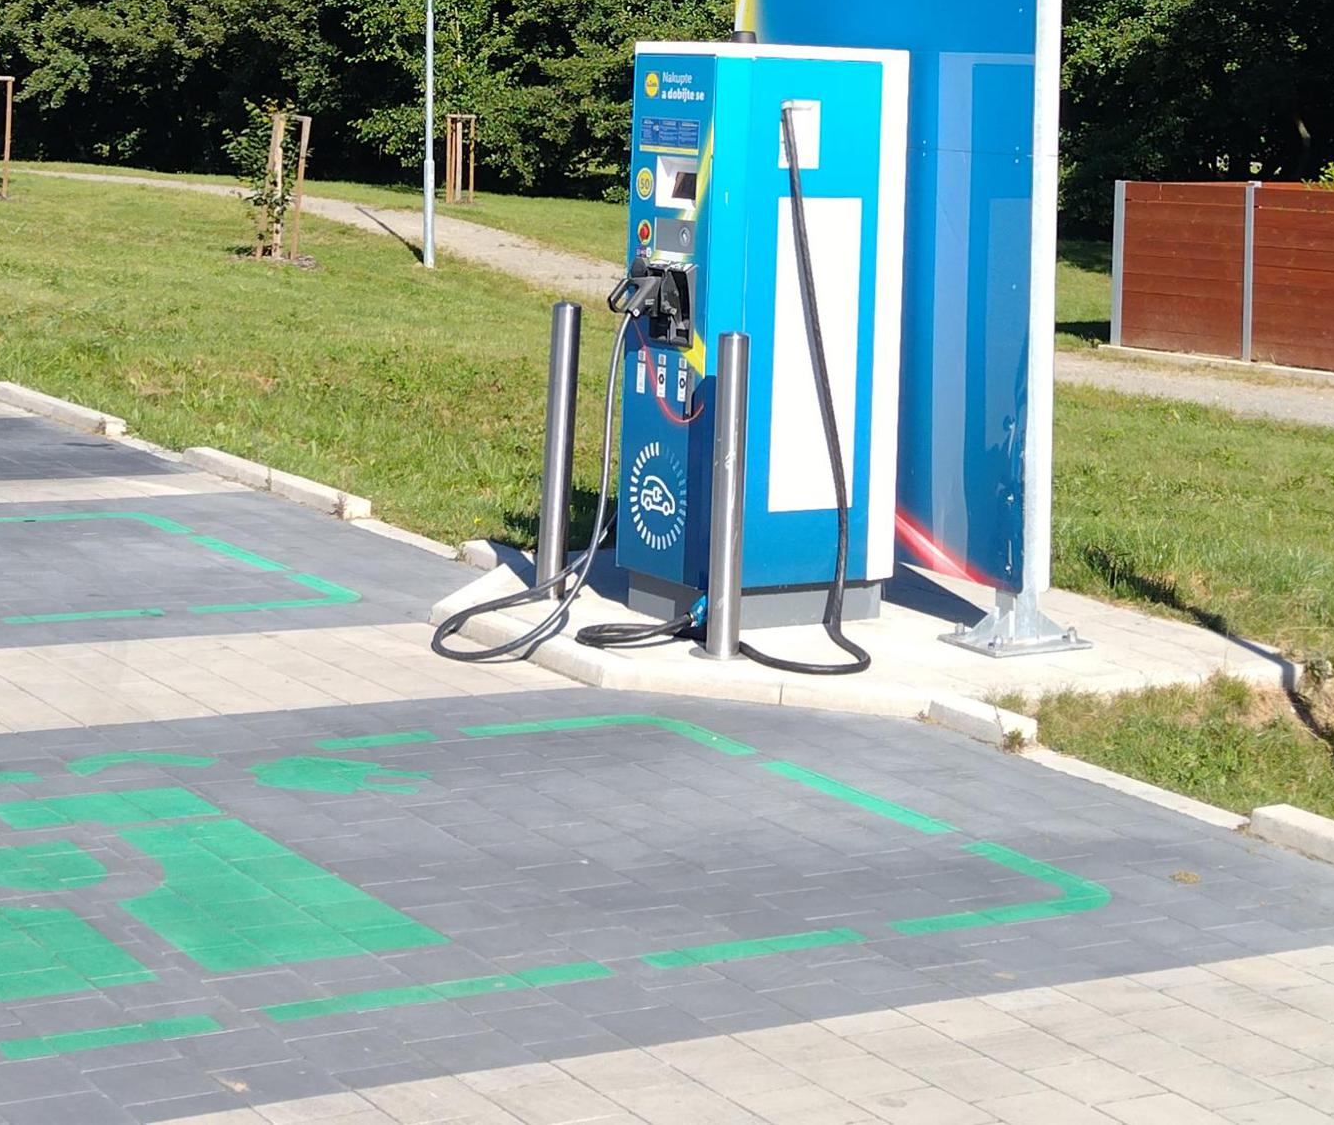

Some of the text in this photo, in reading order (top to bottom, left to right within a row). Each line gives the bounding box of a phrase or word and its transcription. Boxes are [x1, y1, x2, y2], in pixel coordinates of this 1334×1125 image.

[662, 71, 693, 86] Nakupte
[661, 87, 705, 103] a dobijte se
